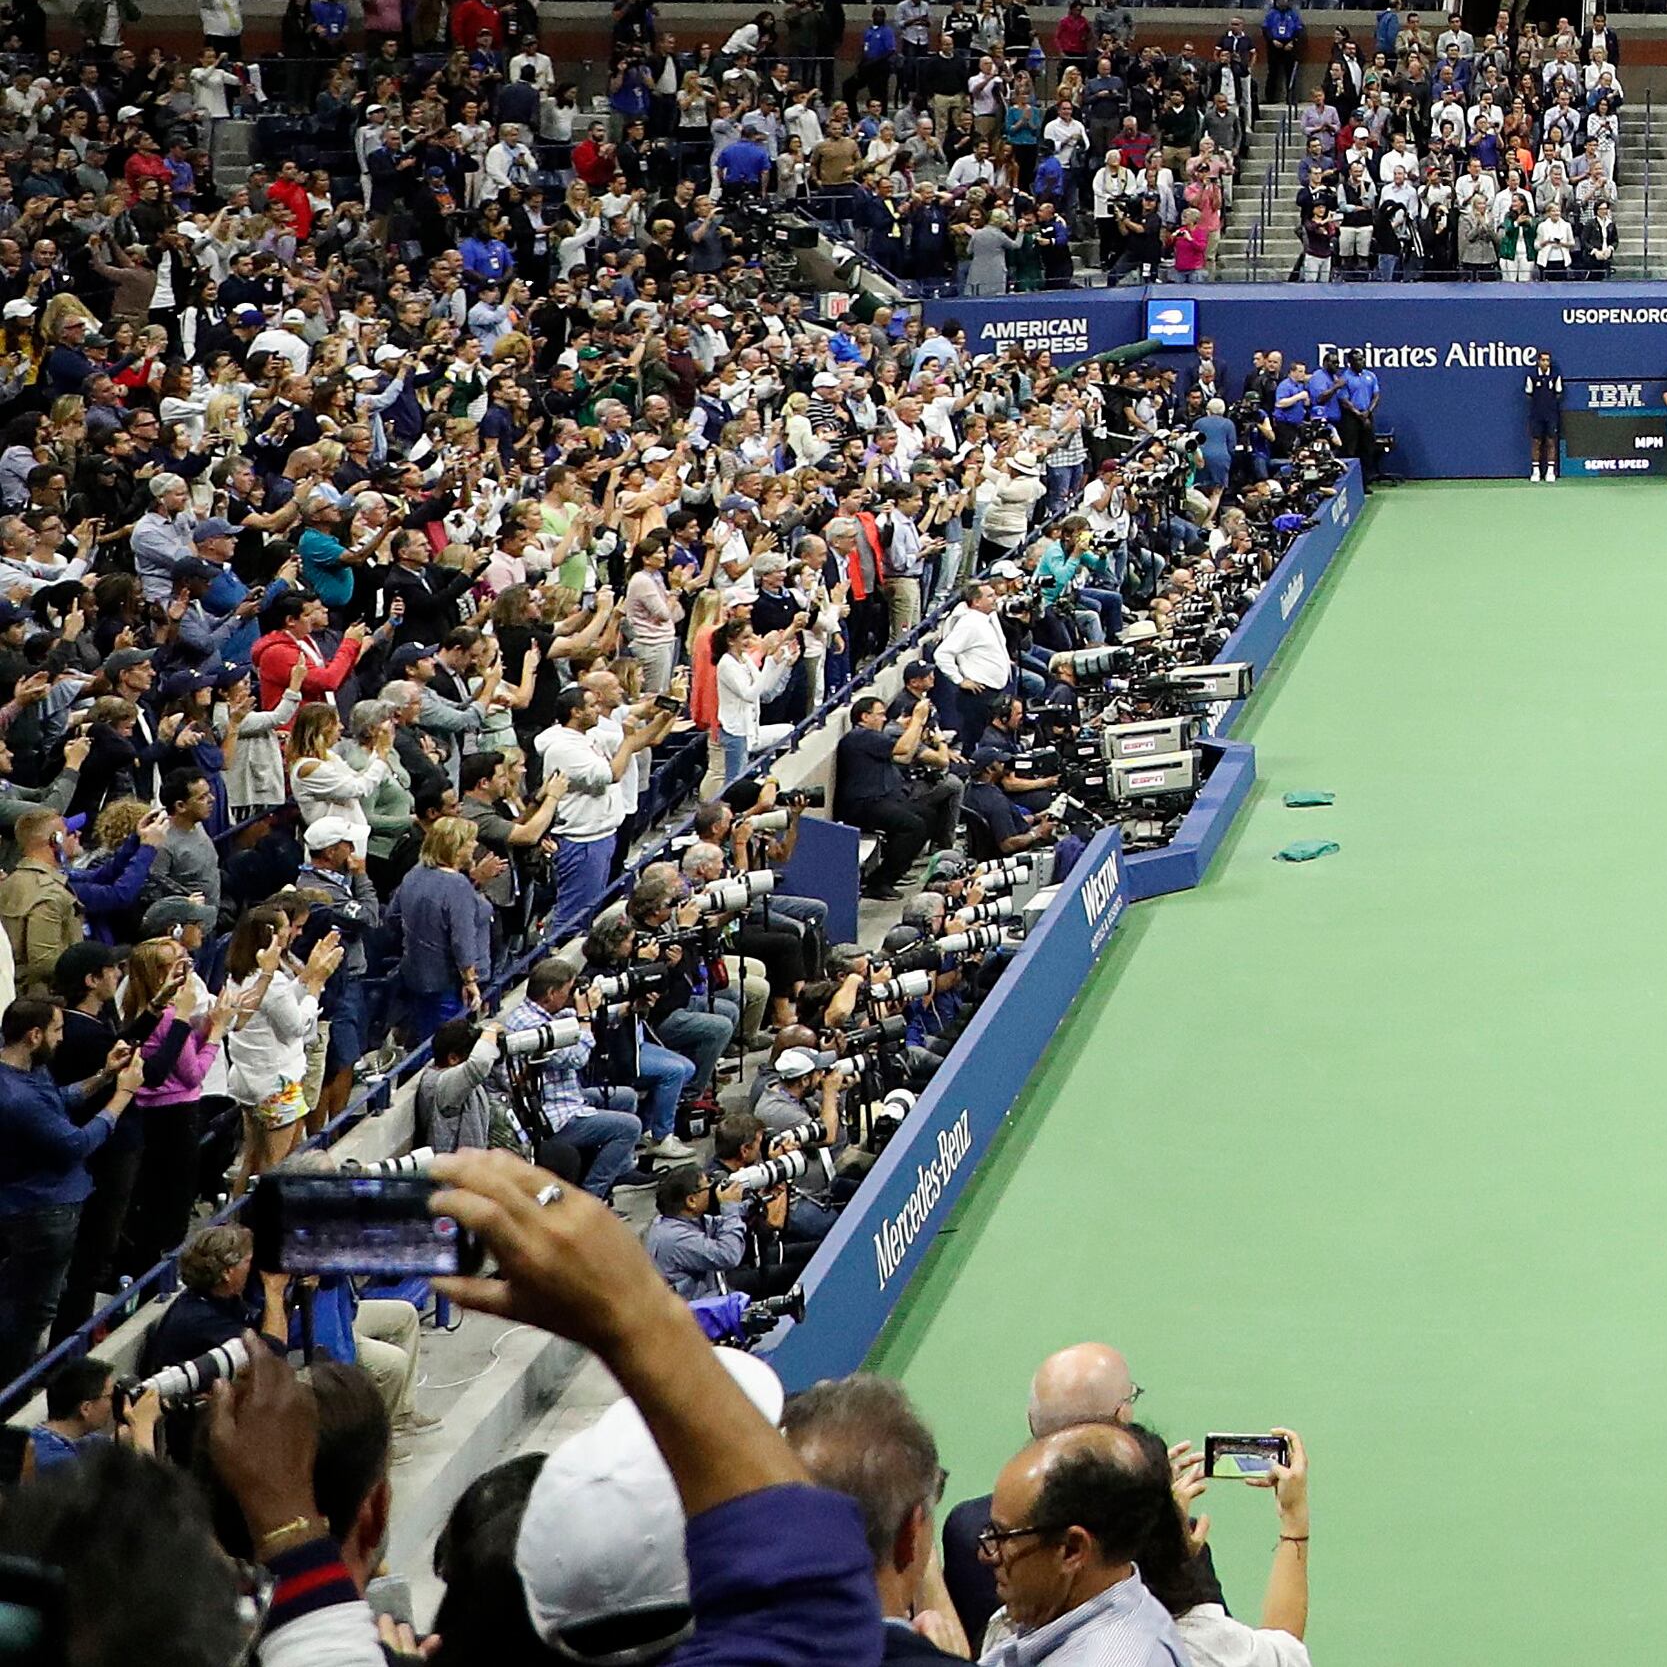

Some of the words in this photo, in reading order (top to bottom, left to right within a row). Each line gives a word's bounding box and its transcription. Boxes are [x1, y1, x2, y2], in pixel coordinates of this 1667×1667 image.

[981, 318, 1087, 340] AMERICAN
[996, 336, 1089, 356] EPRESS
[1445, 341, 1538, 368] Airline
[1588, 384, 1644, 407] IBM
[1635, 436, 1664, 448] MPH
[1584, 459, 1616, 471] SERVE
[1618, 458, 1650, 470] SPEED
[1081, 850, 1119, 927] WESTIN
[873, 1109, 972, 1291] Mercedes-Benz
